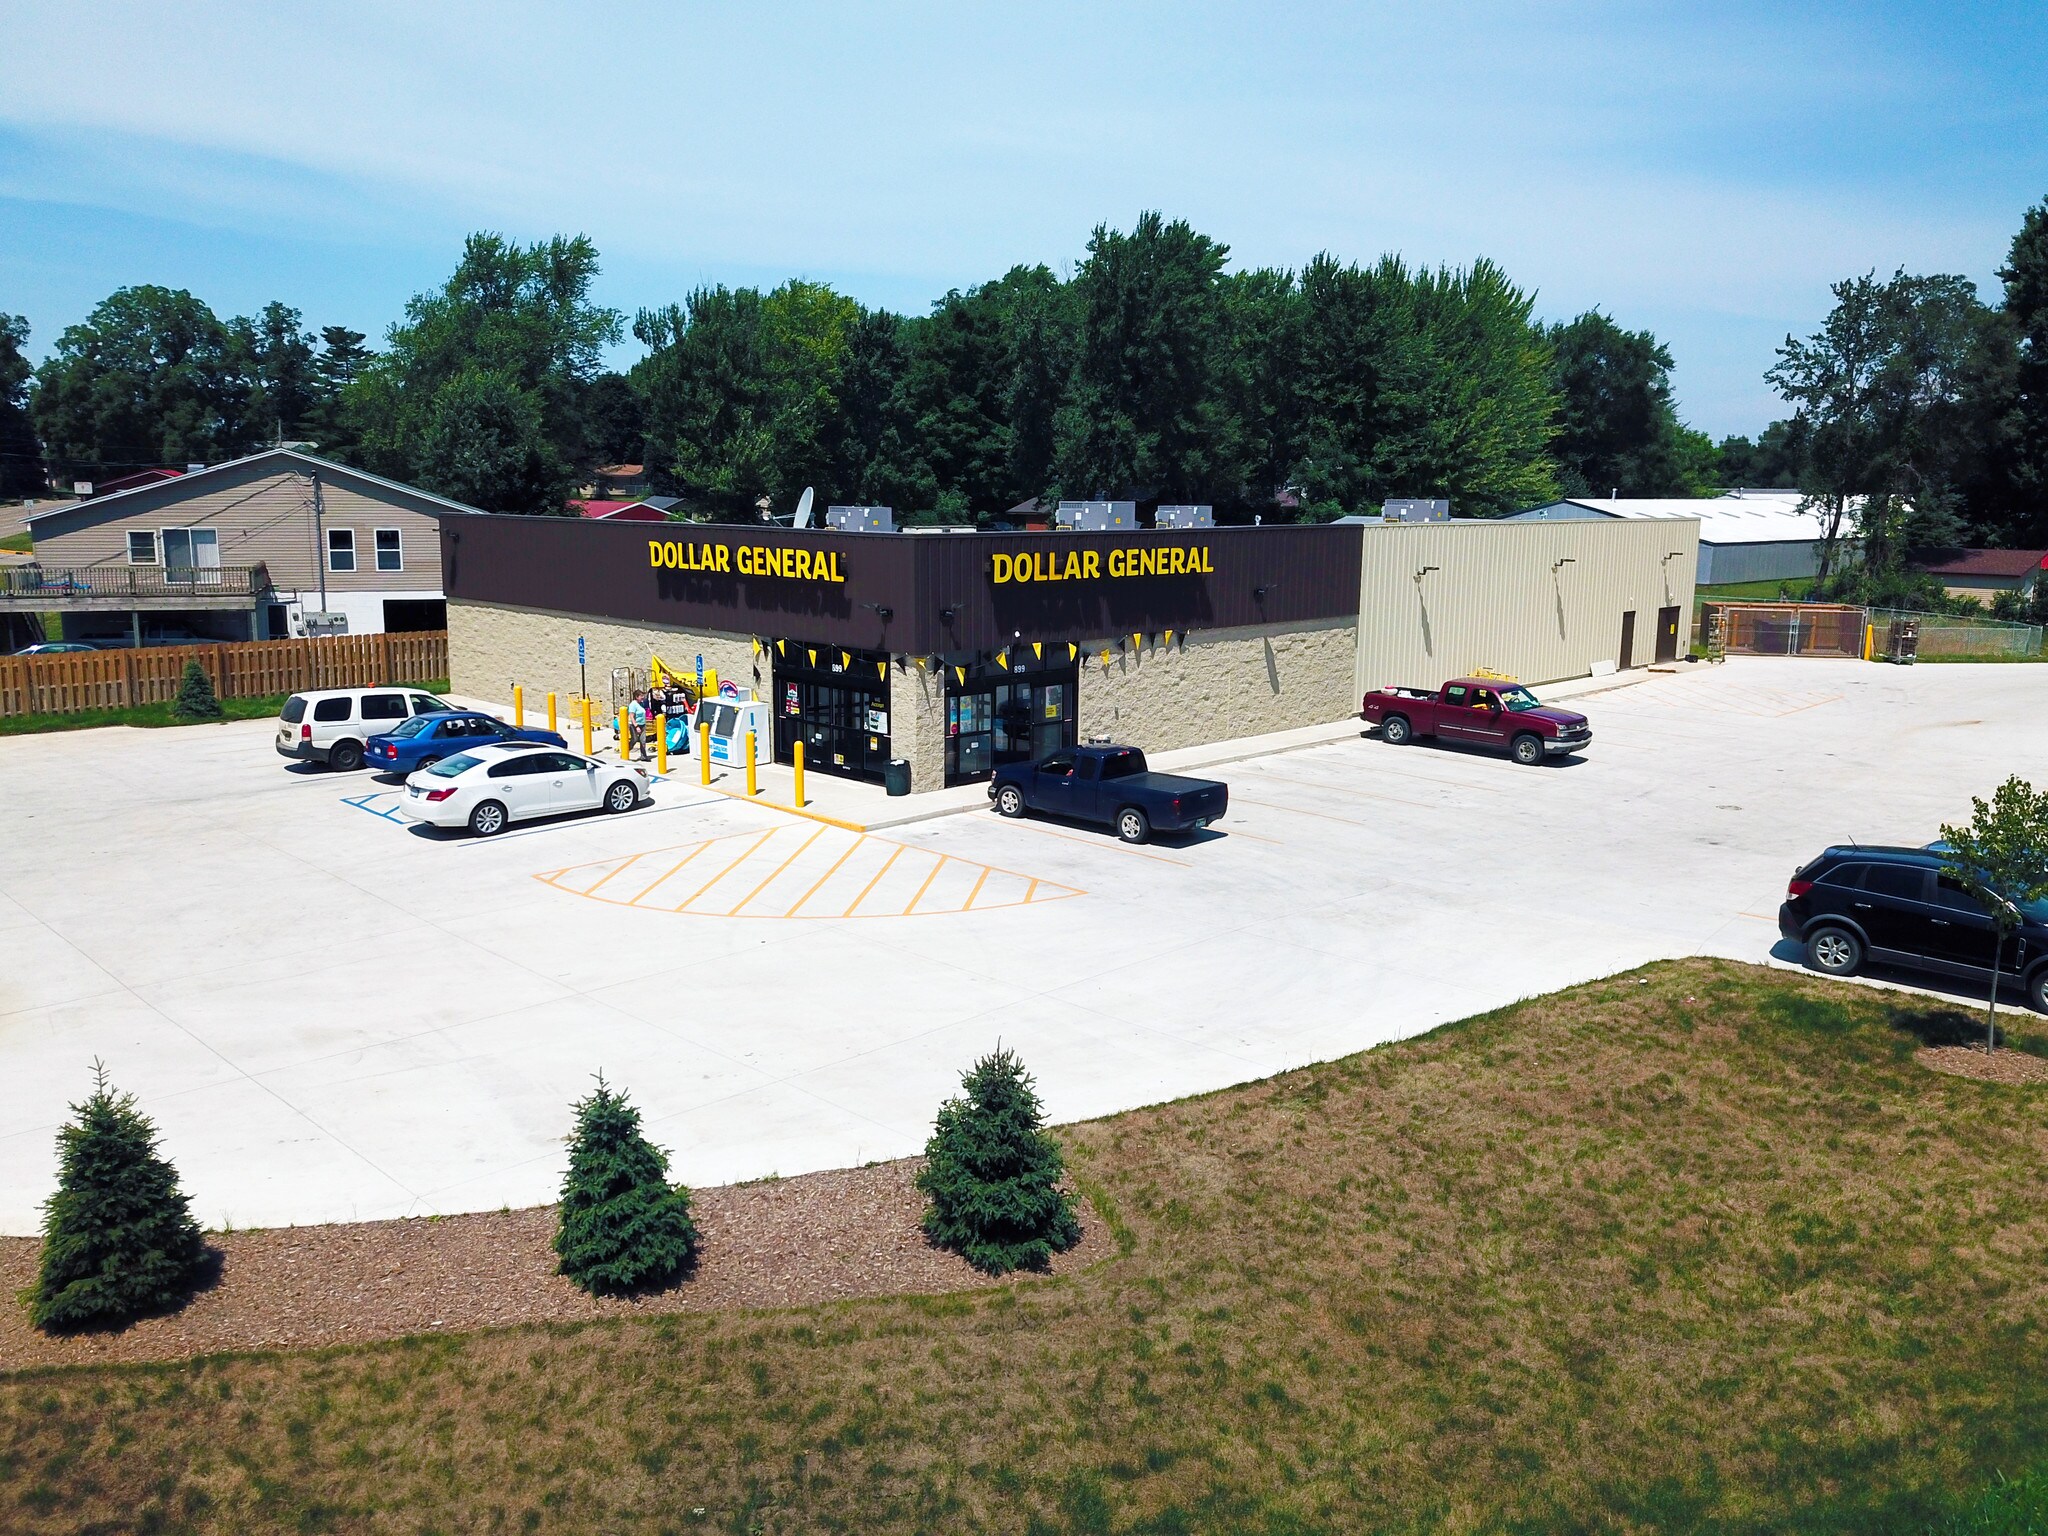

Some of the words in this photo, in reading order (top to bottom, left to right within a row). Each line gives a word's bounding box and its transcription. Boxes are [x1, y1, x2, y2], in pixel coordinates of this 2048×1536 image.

[649, 541, 730, 573] DOLLAR
[736, 545, 845, 583] GENERAL
[992, 550, 1101, 584] DOLLAR
[1108, 546, 1214, 578] GENERAL
[1014, 665, 1026, 674] 899
